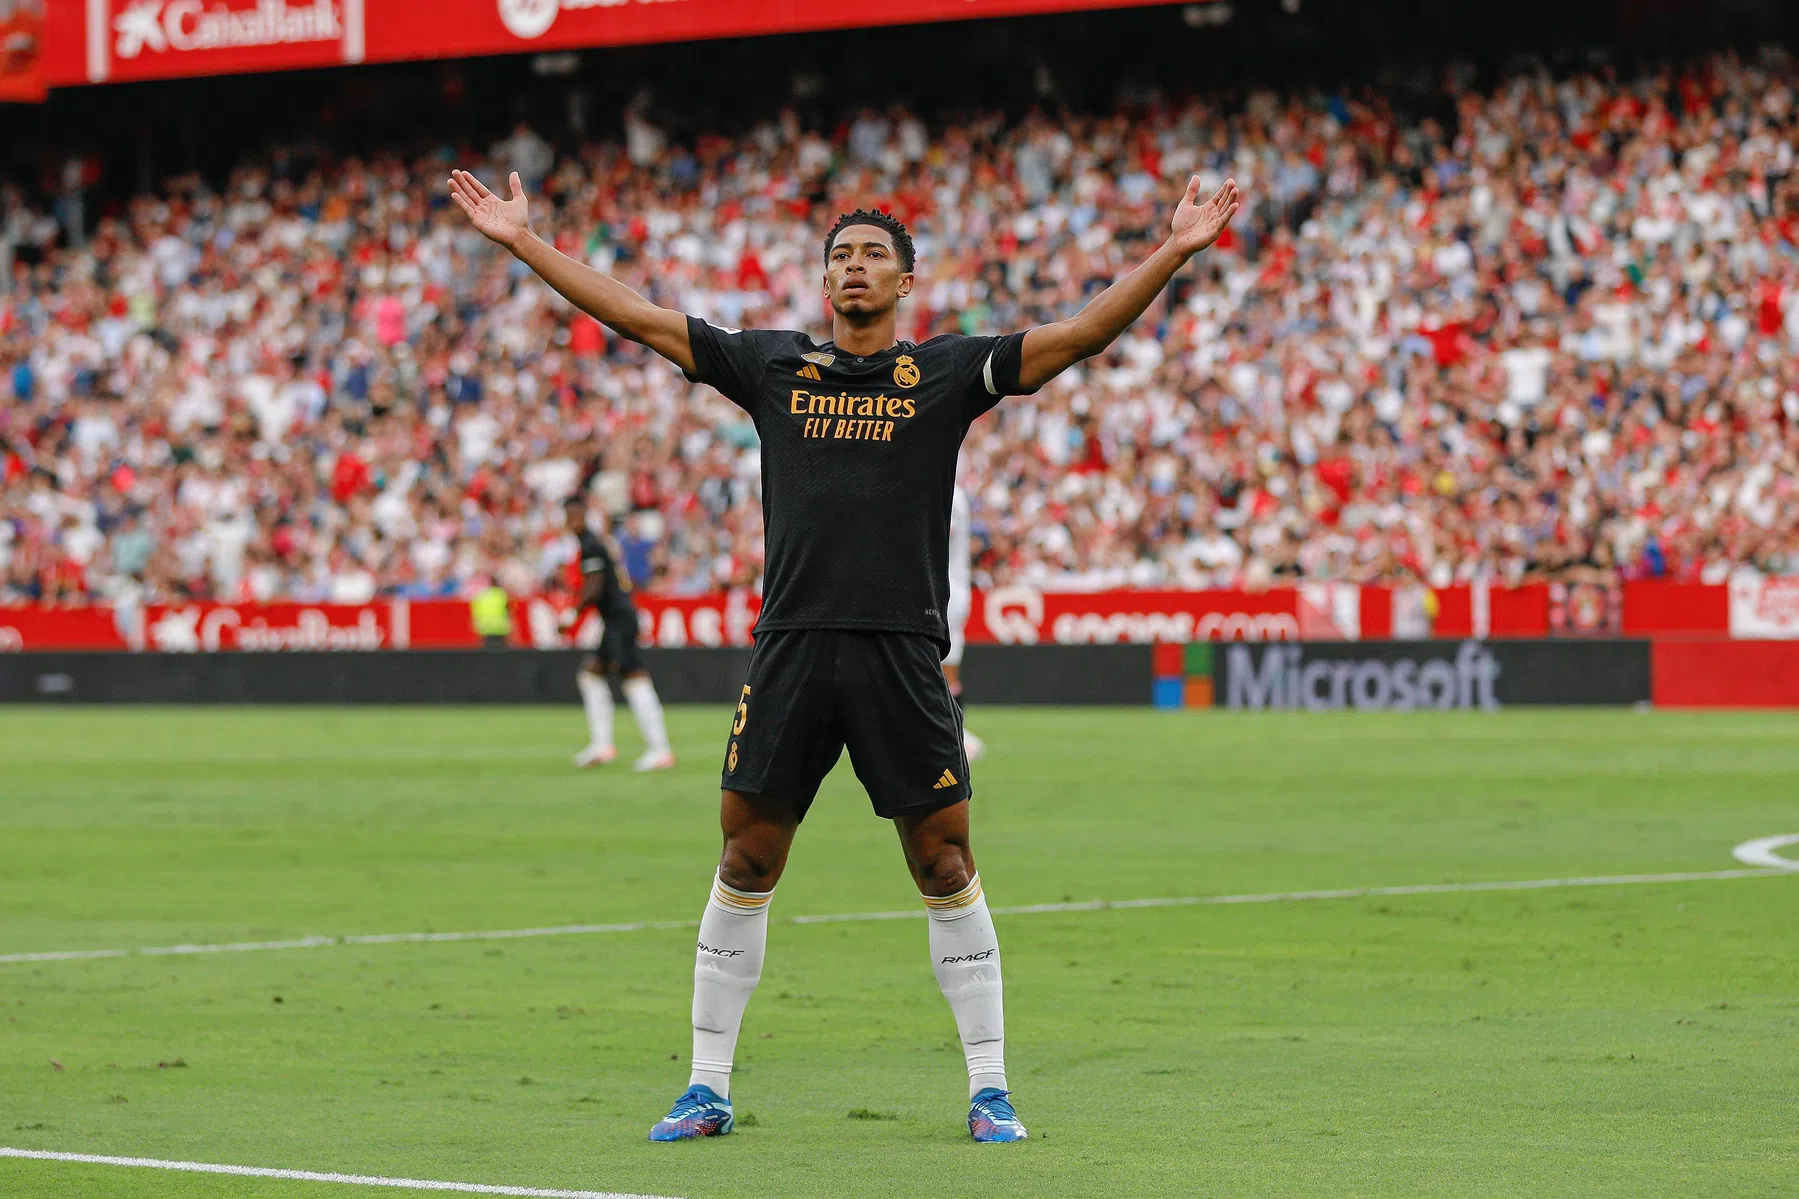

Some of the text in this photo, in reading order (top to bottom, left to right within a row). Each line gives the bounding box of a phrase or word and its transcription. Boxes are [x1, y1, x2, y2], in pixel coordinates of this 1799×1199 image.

[163, 0, 342, 50] CaixaBank
[790, 389, 916, 418] Emirates
[803, 417, 895, 441] FLY BETTER
[1226, 640, 1502, 713] Microsoft
[733, 684, 751, 735] 5
[697, 941, 745, 957] RMCF
[941, 948, 995, 964] RMCF
